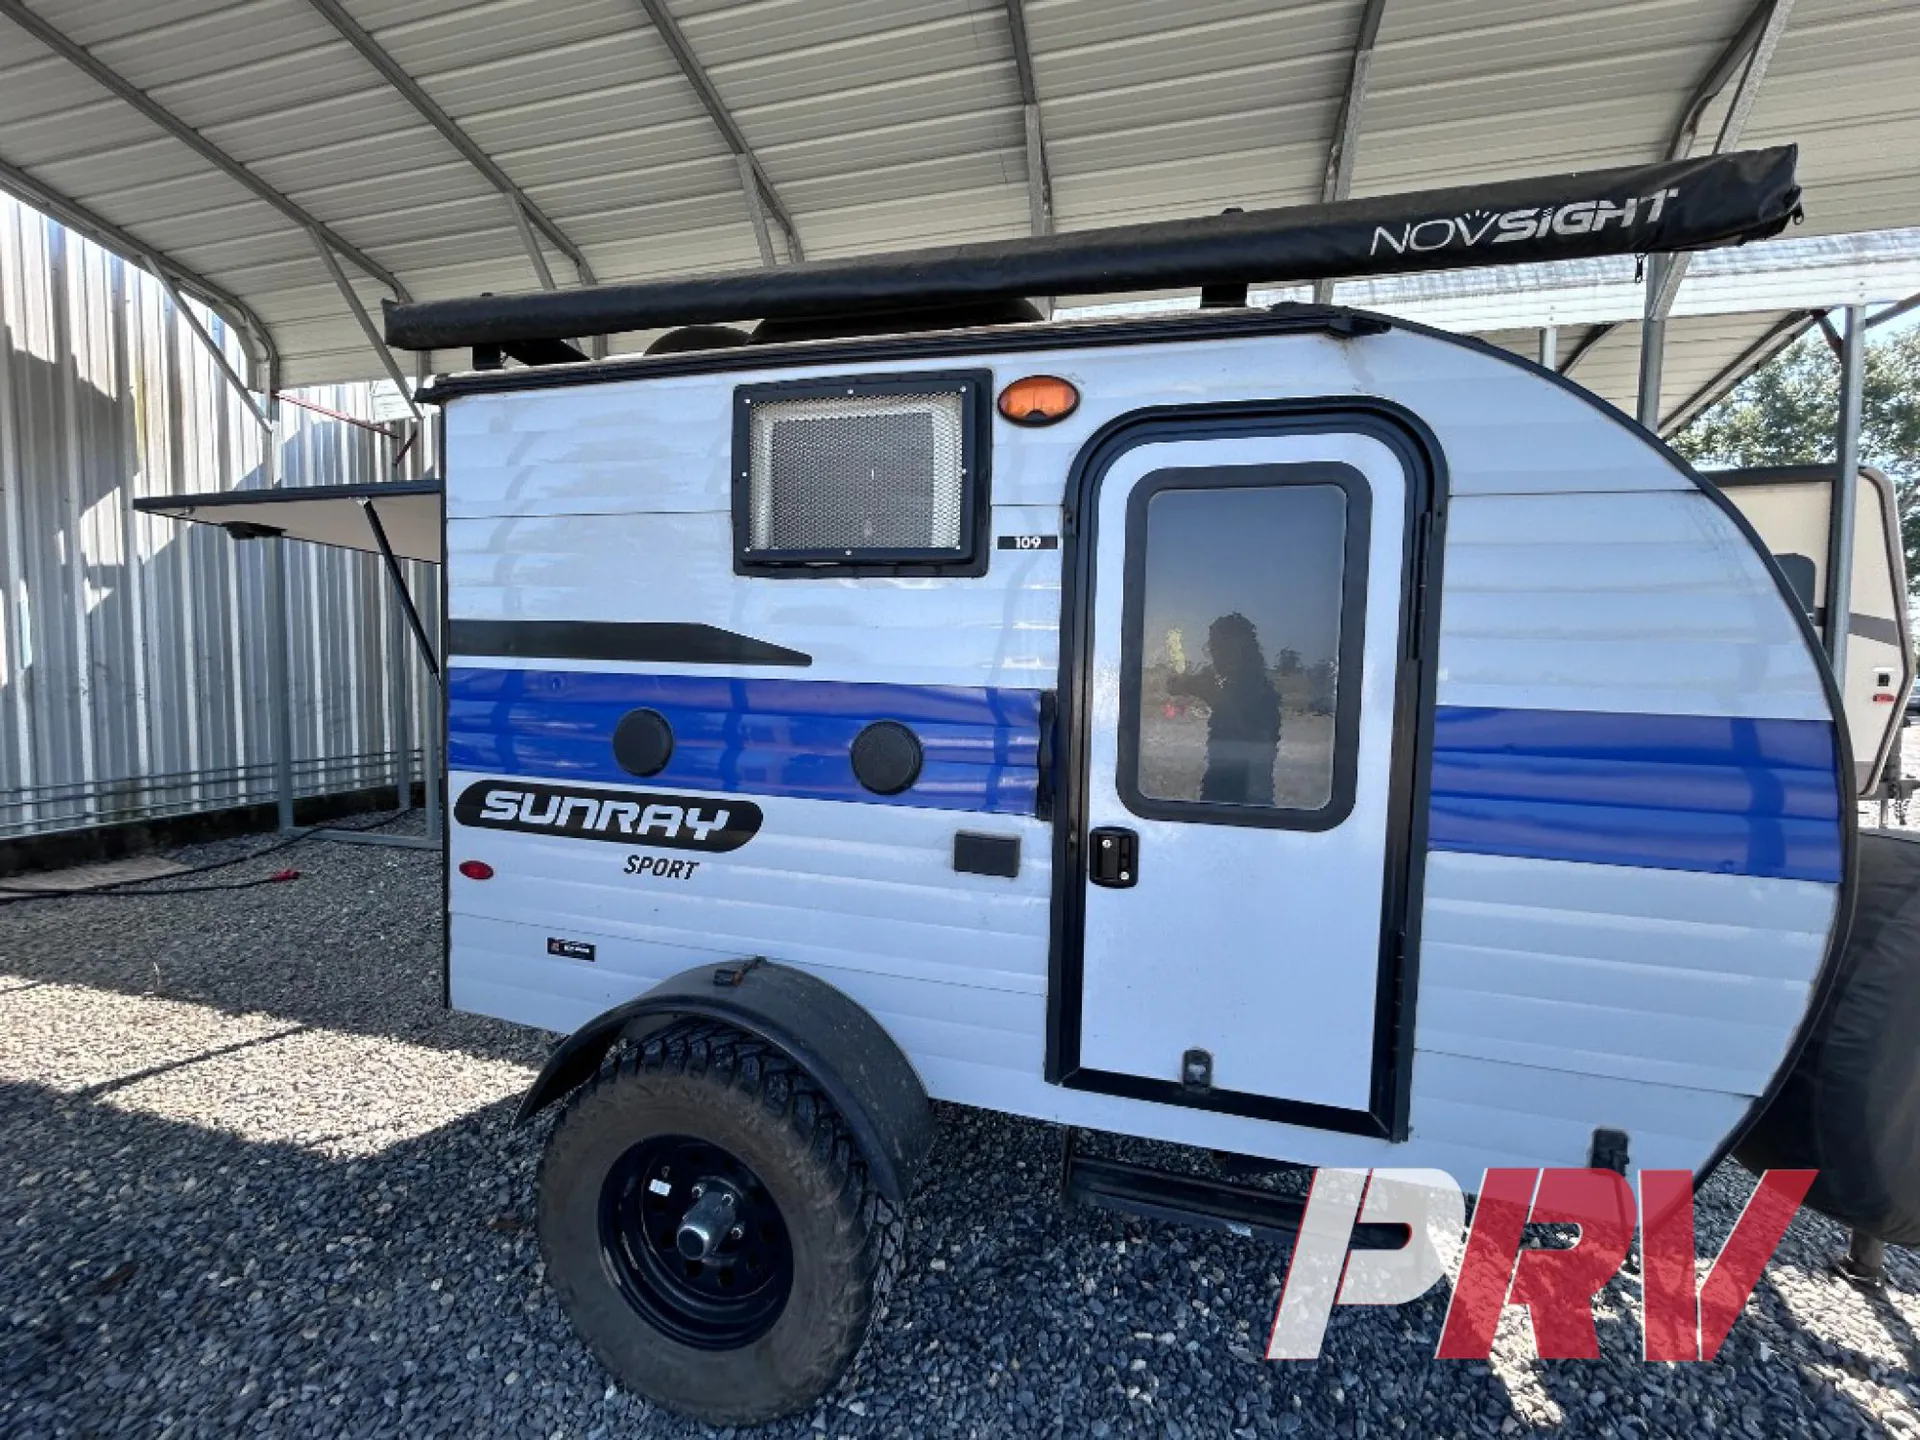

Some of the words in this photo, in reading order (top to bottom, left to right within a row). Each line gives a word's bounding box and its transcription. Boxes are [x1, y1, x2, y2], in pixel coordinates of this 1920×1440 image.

[1014, 536, 1042, 549] 109
[480, 790, 730, 841] SUNRAY
[624, 854, 699, 880] SPORT
